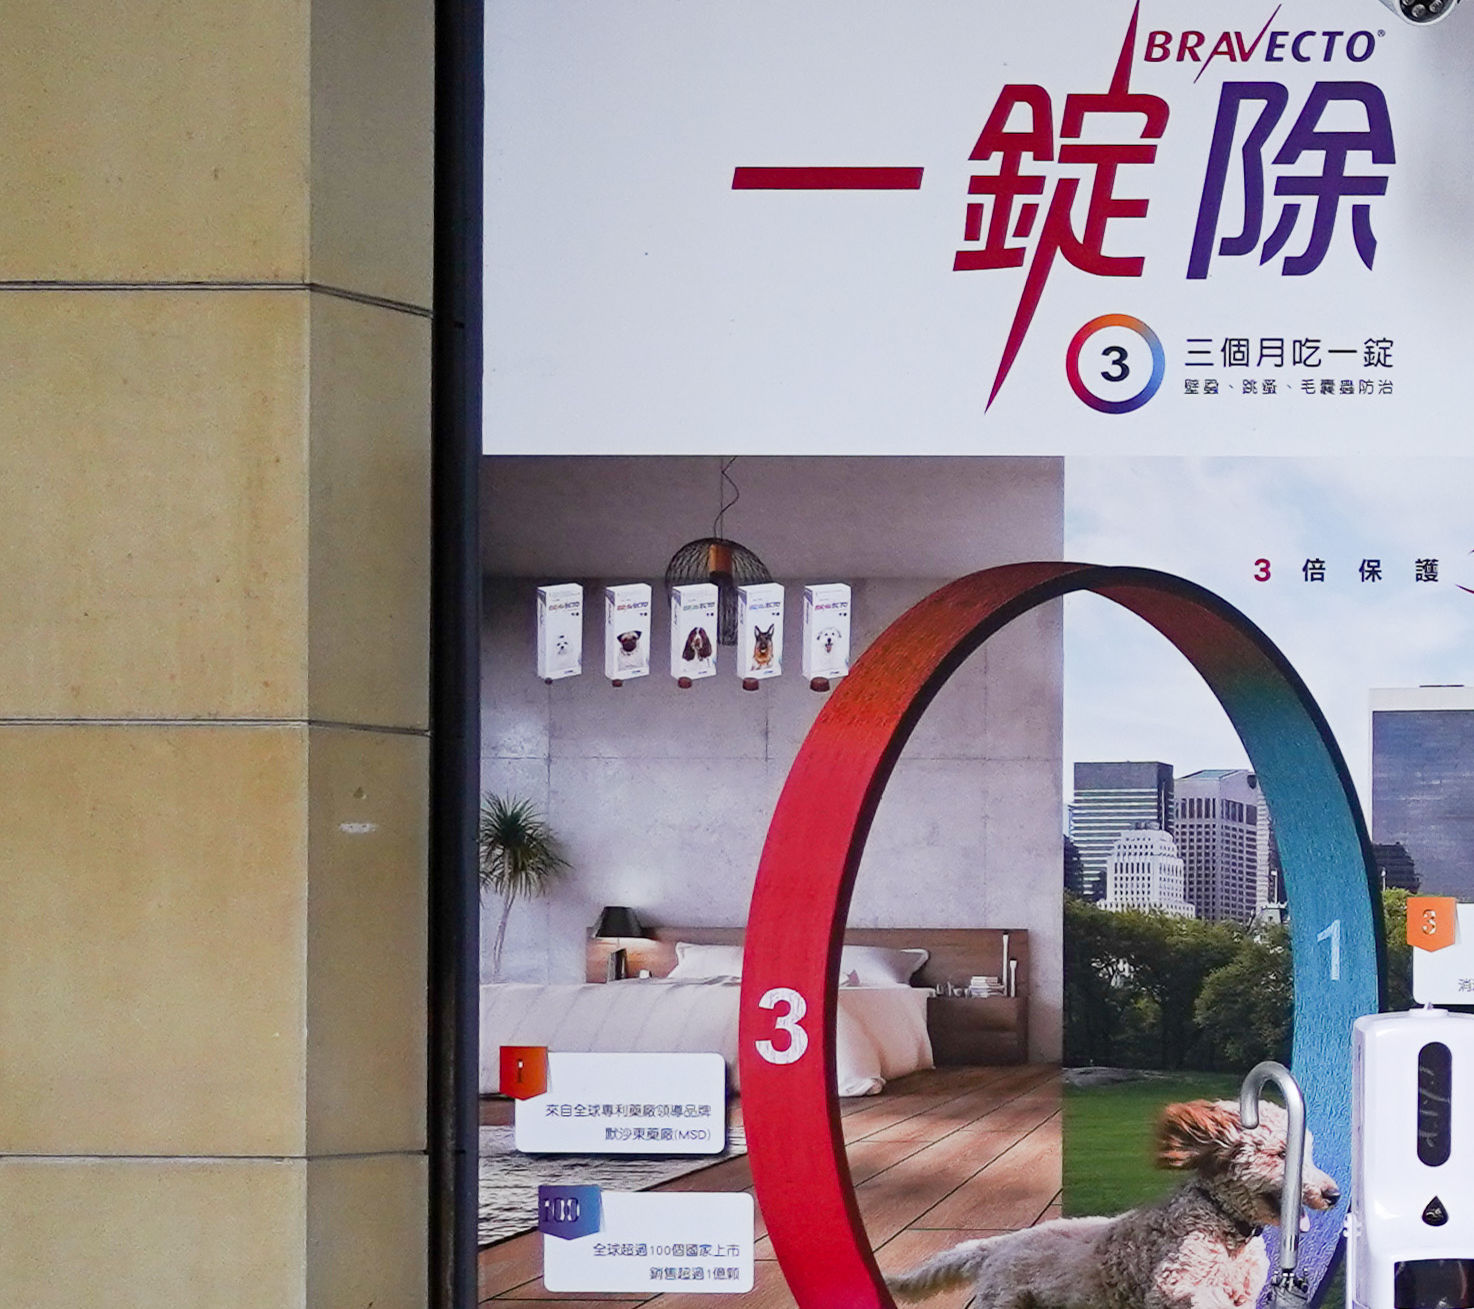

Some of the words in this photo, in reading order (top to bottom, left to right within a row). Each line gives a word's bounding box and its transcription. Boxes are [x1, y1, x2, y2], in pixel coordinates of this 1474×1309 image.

[1099, 345, 1130, 383] 3
[1185, 337, 1394, 368] 三個月吃一錠
[1316, 919, 1342, 981] 1
[754, 988, 809, 1065] 3
